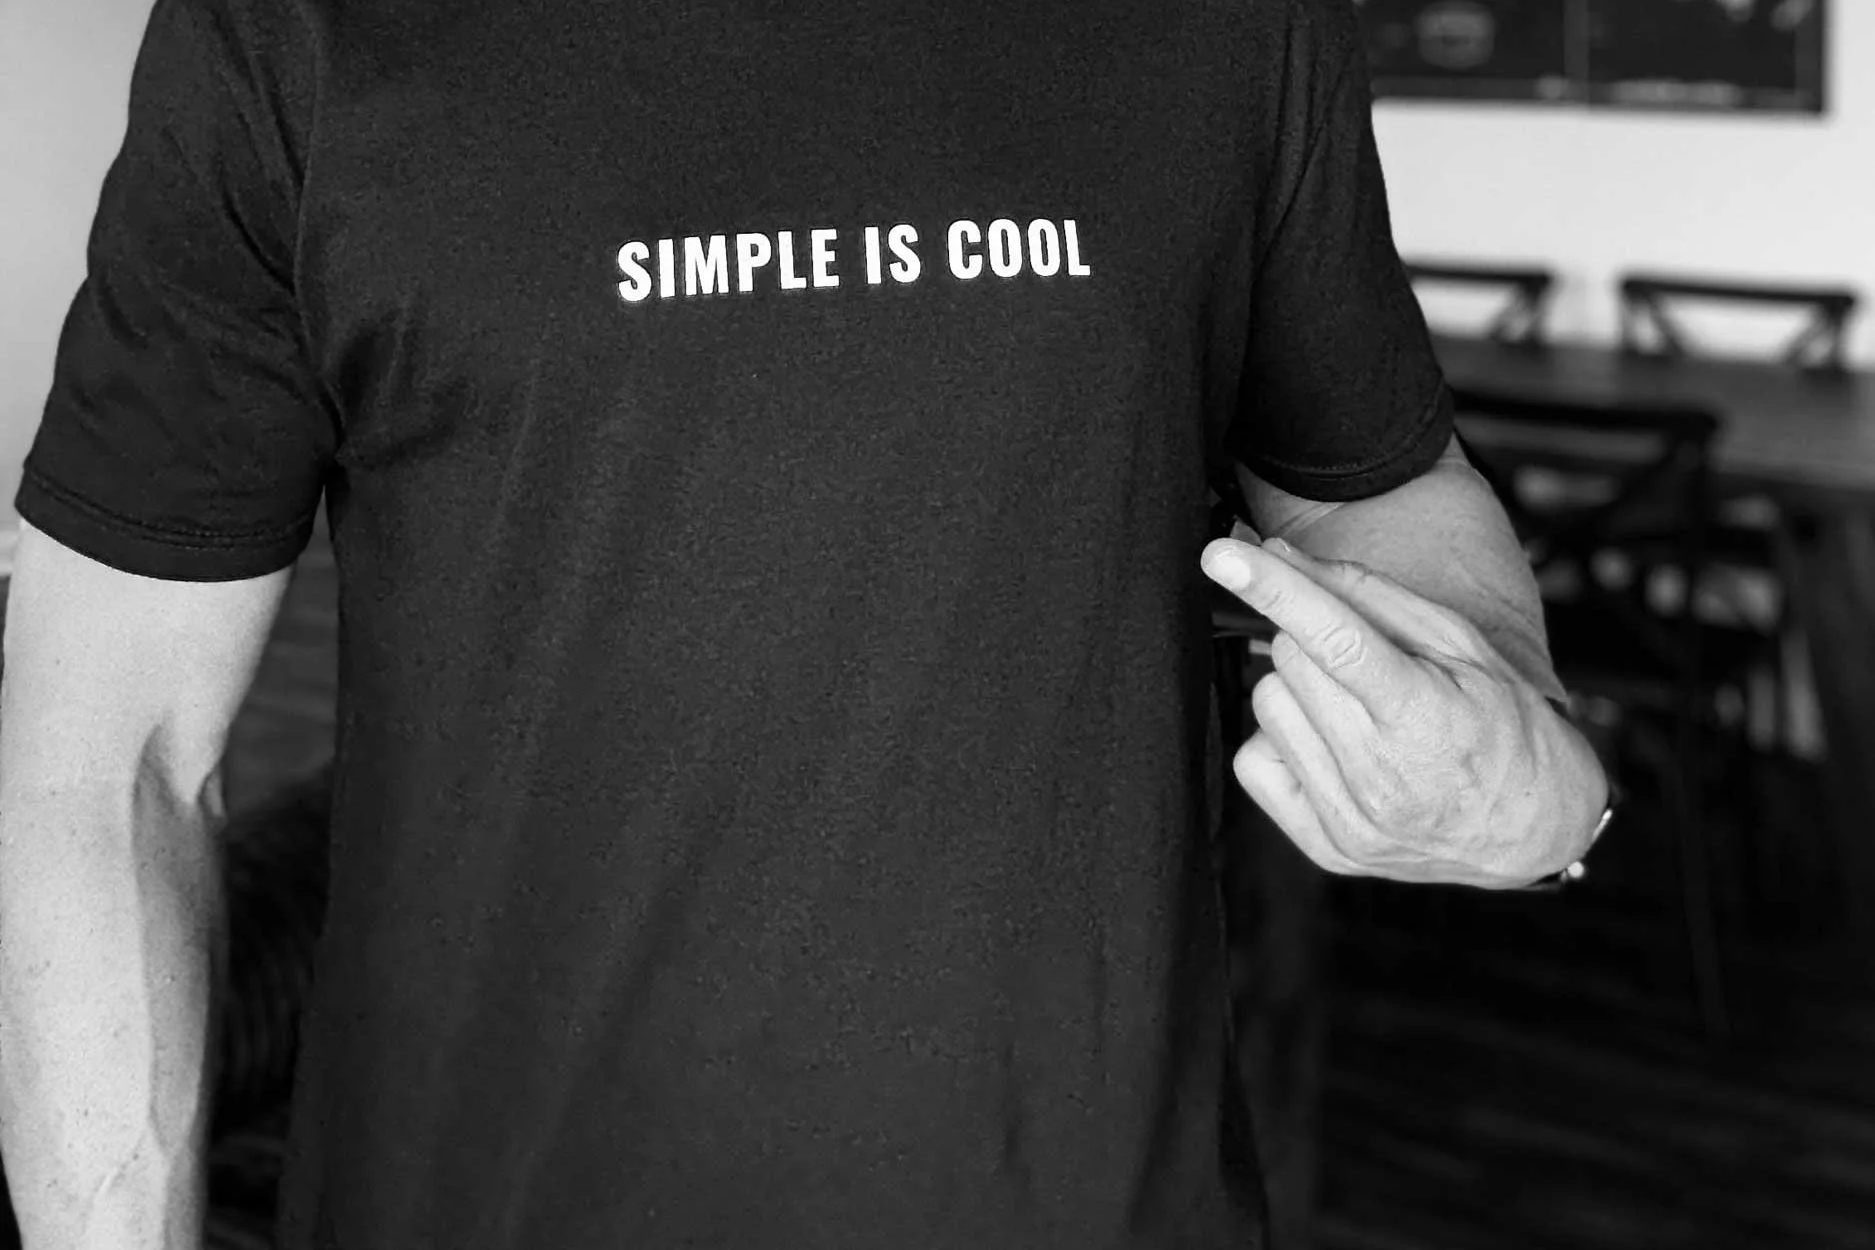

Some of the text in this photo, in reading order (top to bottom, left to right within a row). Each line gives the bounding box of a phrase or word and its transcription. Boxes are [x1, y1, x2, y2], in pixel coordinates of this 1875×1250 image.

[617, 218, 1091, 302] SIMPLE IS COOL
